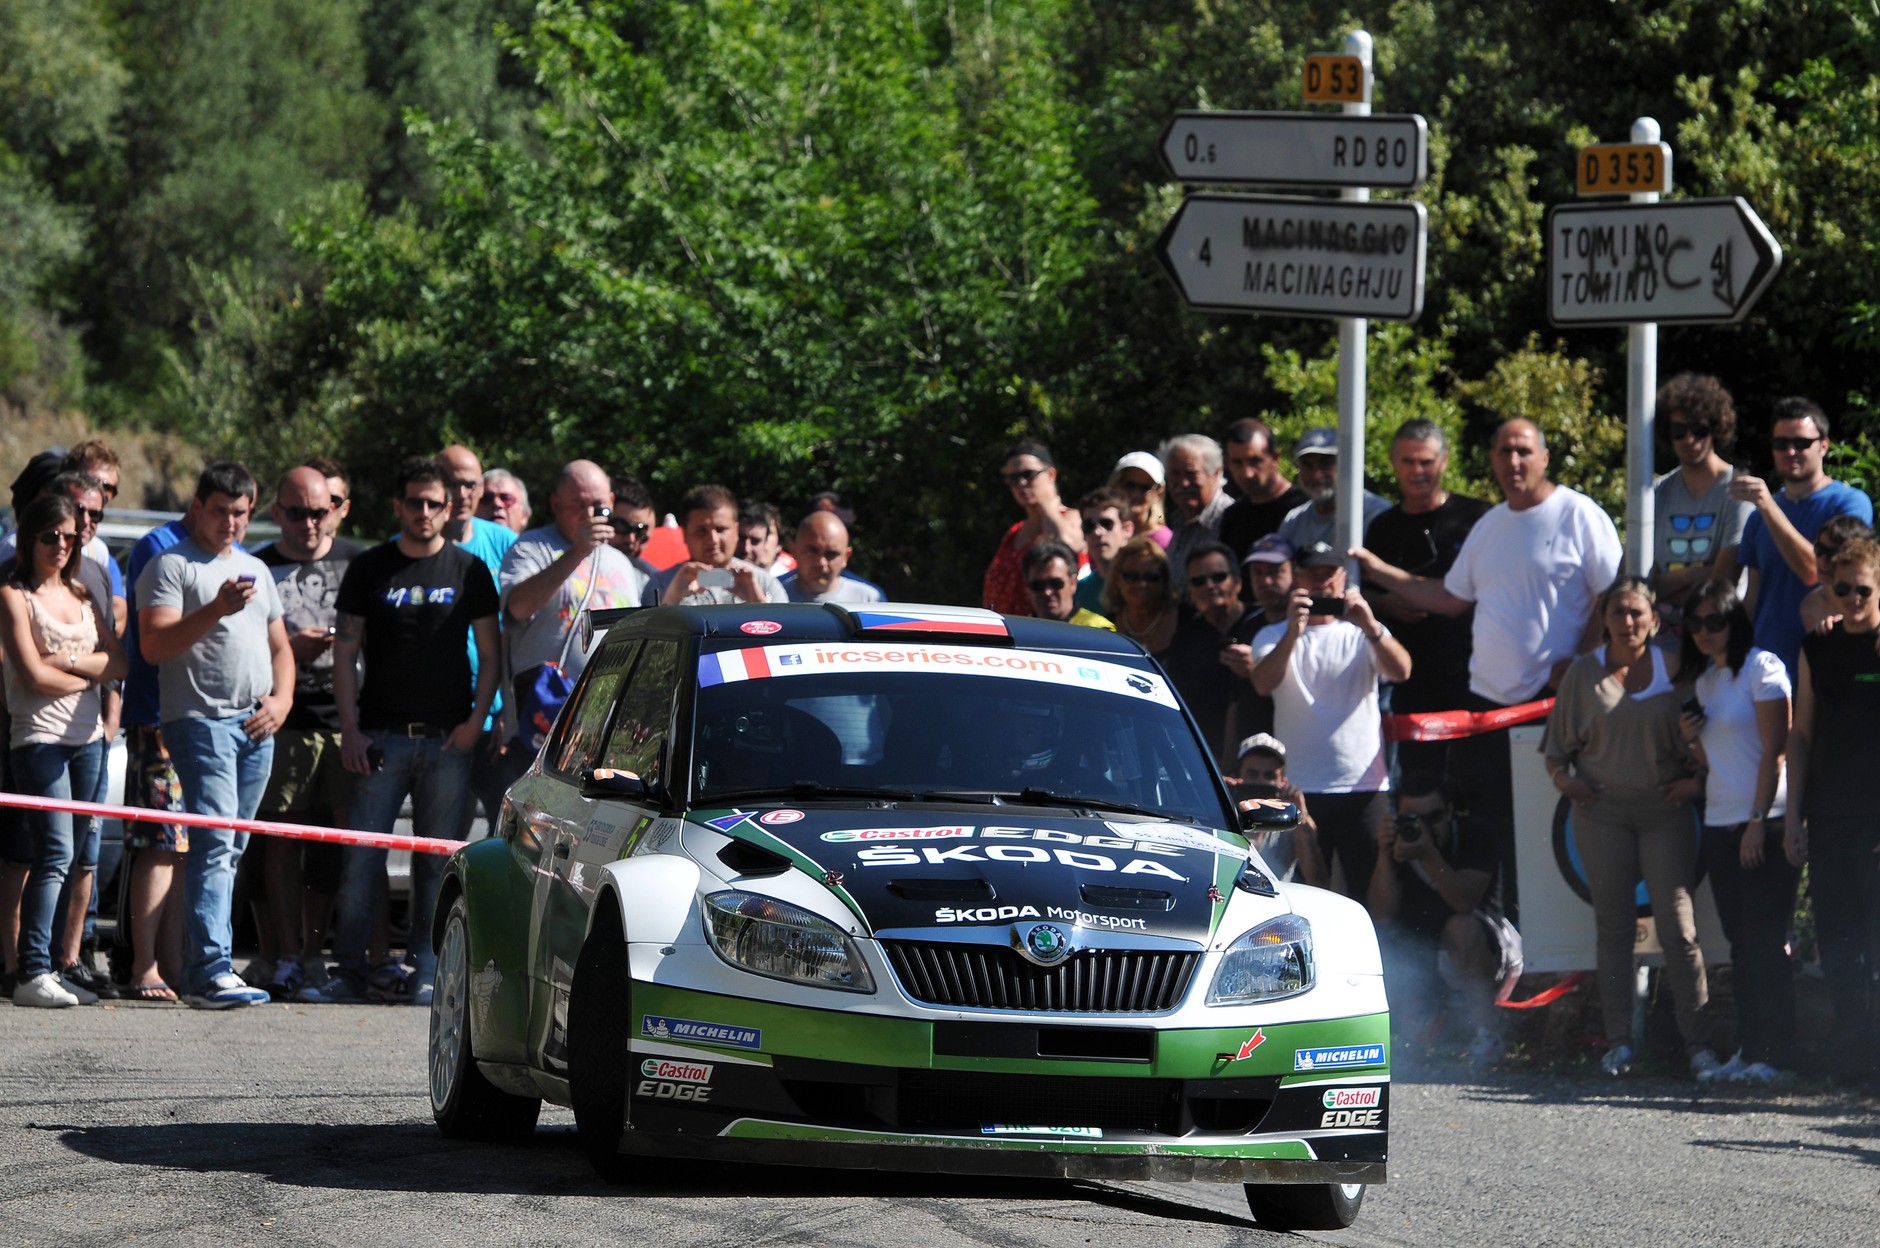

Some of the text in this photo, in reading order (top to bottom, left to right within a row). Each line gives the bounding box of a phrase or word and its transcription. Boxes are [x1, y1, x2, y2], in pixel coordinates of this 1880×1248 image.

[1307, 63, 1358, 94] D 53
[1585, 152, 1655, 186] D 353
[1199, 236, 1213, 268] 4
[1560, 223, 1669, 260] TOMINO
[1242, 261, 1403, 299] MACINAGHJU
[1560, 269, 1658, 305] TOMINU
[814, 647, 1064, 675] ircseries.com
[859, 827, 964, 840] Castrol
[979, 826, 1187, 858] EDGE
[856, 844, 1188, 883] ŠKODA
[935, 905, 1147, 930] ŠKODA Motorsport
[673, 1023, 756, 1042] MICHELIN
[1315, 1048, 1380, 1063] MICHELIN
[658, 1062, 708, 1081] Castrol
[635, 1080, 714, 1103] EDGE
[1336, 1090, 1377, 1106] Castrol
[1320, 1109, 1384, 1129] EDGE
